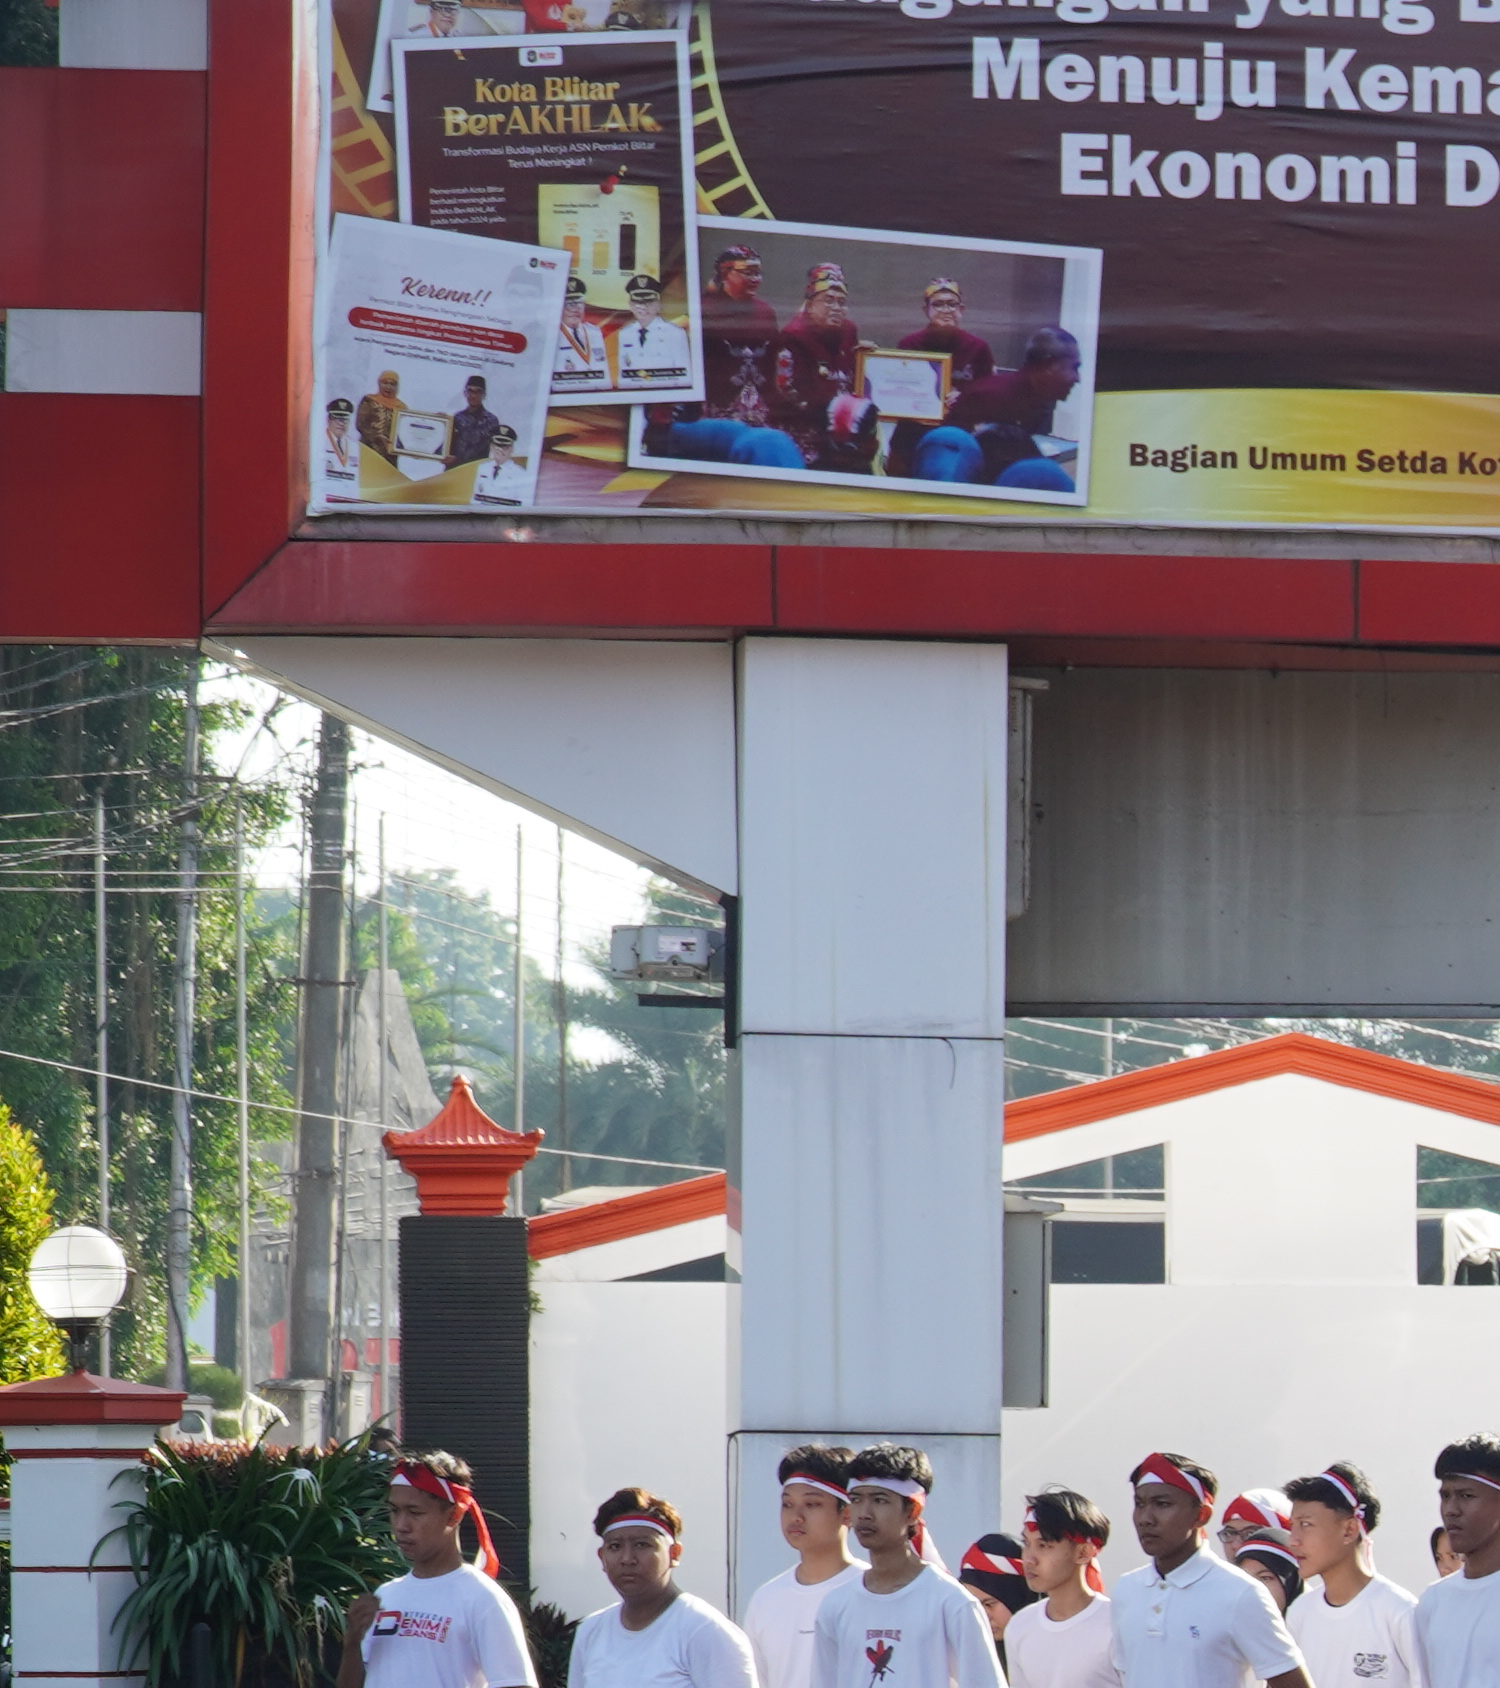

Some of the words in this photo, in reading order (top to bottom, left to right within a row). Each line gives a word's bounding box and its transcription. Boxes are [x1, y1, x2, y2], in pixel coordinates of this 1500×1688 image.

[475, 79, 536, 103] Kota
[544, 77, 620, 101] Blitar
[972, 36, 1275, 120] Menuju
[443, 103, 656, 137] BerAKHLAK
[443, 147, 504, 157] Transformasi
[506, 145, 541, 157] Budaya
[569, 143, 591, 152] ASN
[1061, 133, 1417, 205] Ekonomi
[401, 276, 492, 308] Kerenn!!
[1129, 443, 1237, 473] Bagian
[1248, 446, 1347, 472] Umum
[1356, 448, 1447, 475] Setda
